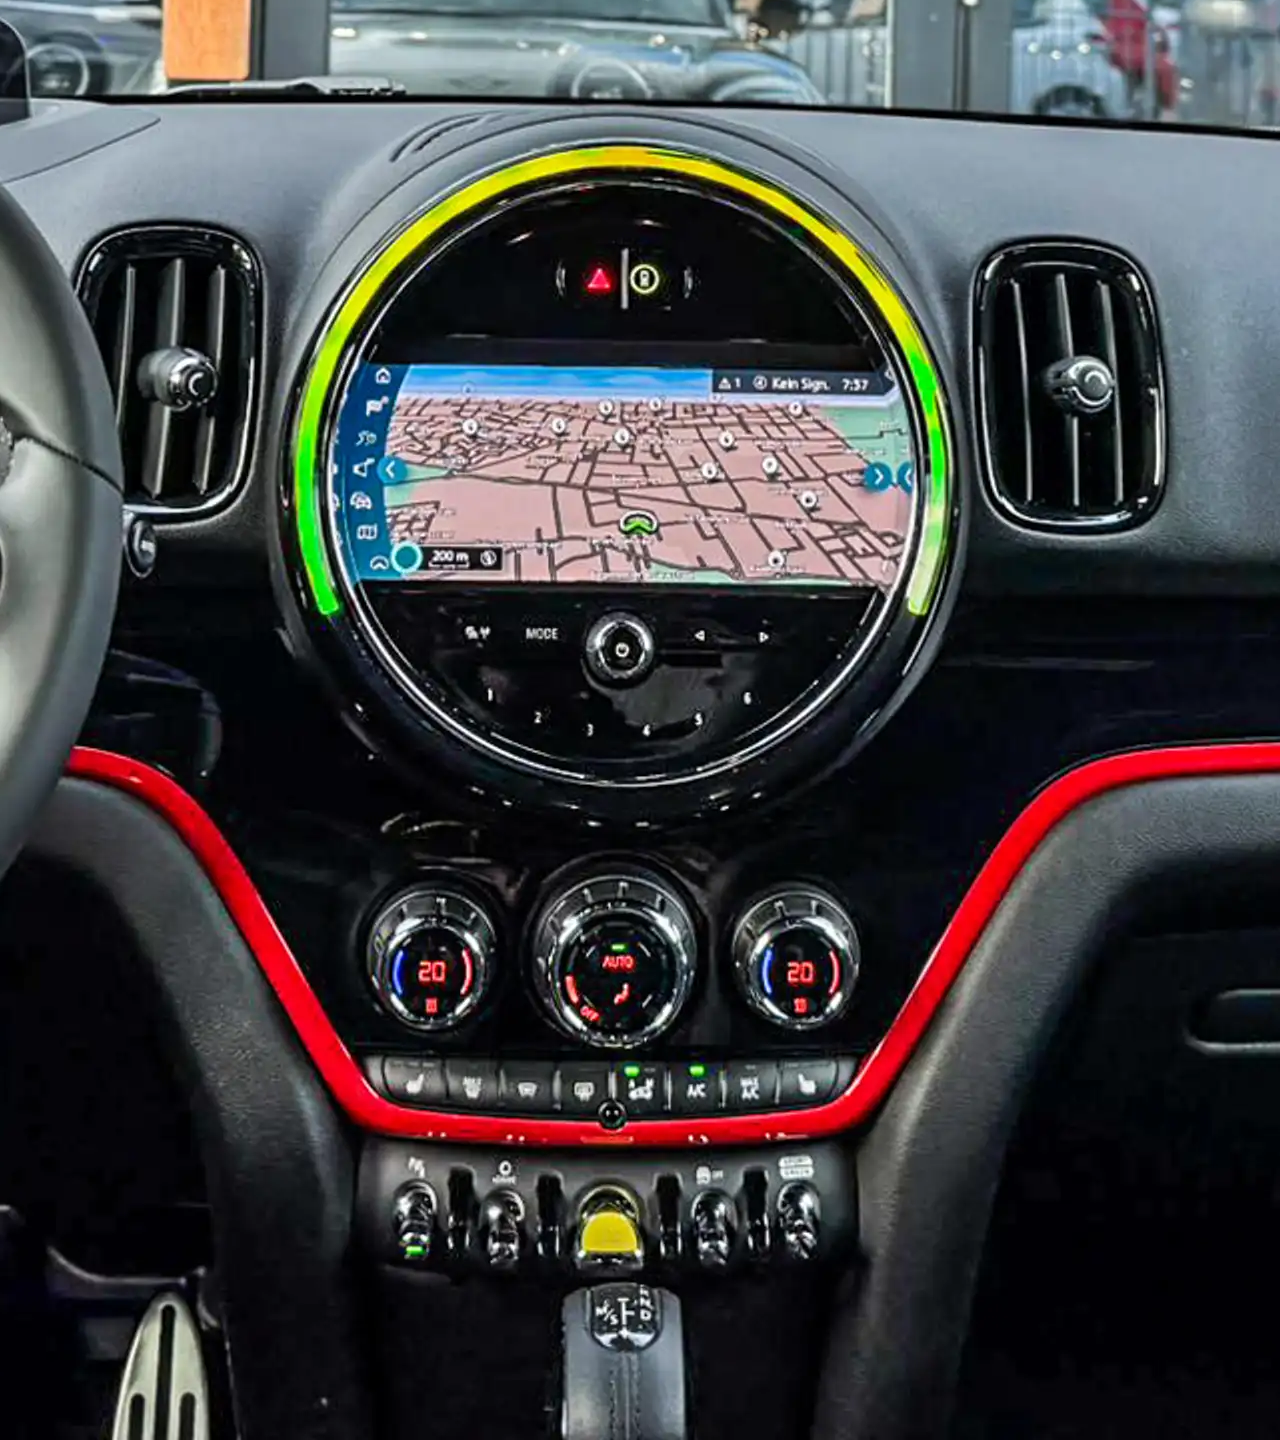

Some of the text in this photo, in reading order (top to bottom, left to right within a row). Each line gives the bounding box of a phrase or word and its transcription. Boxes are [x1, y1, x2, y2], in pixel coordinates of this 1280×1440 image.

[734, 377, 742, 388] 1
[772, 376, 831, 393] Kein Sign.
[431, 549, 470, 562] 200 m
[525, 627, 559, 640] MODE
[486, 688, 494, 702] 1
[742, 691, 752, 705] 6
[533, 711, 542, 724] 2
[694, 713, 704, 726] 5
[586, 723, 594, 736] 3
[642, 723, 652, 737] 4
[601, 955, 634, 969] AUTO
[418, 961, 446, 982] 20
[787, 961, 814, 982] 20
[580, 1005, 599, 1021] OFF
[686, 1083, 706, 1098] A/C
[640, 1310, 652, 1321] D
